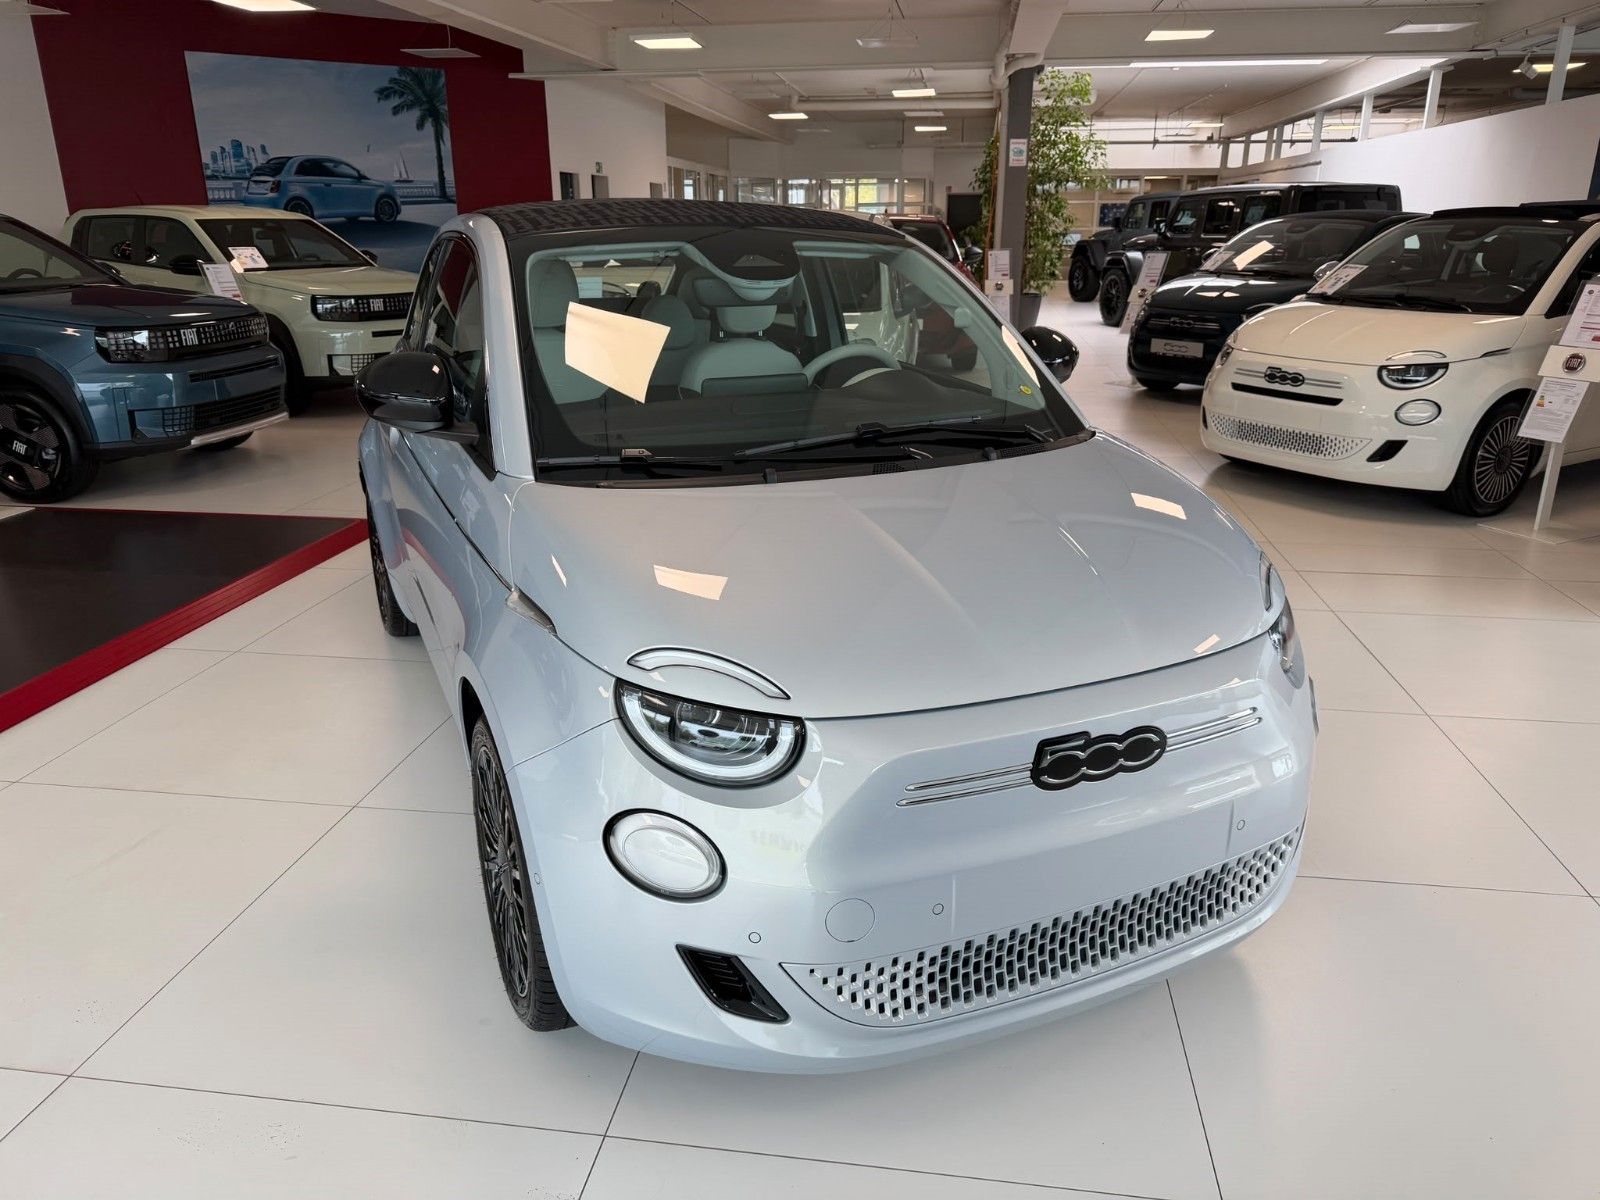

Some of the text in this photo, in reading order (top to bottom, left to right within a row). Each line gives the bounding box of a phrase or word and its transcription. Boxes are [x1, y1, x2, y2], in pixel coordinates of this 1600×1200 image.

[369, 298, 384, 312] FIAT
[180, 328, 199, 346] FIAT
[1265, 367, 1303, 386] 500
[12, 440, 28, 455] FIAT
[1036, 731, 1163, 787] 500
